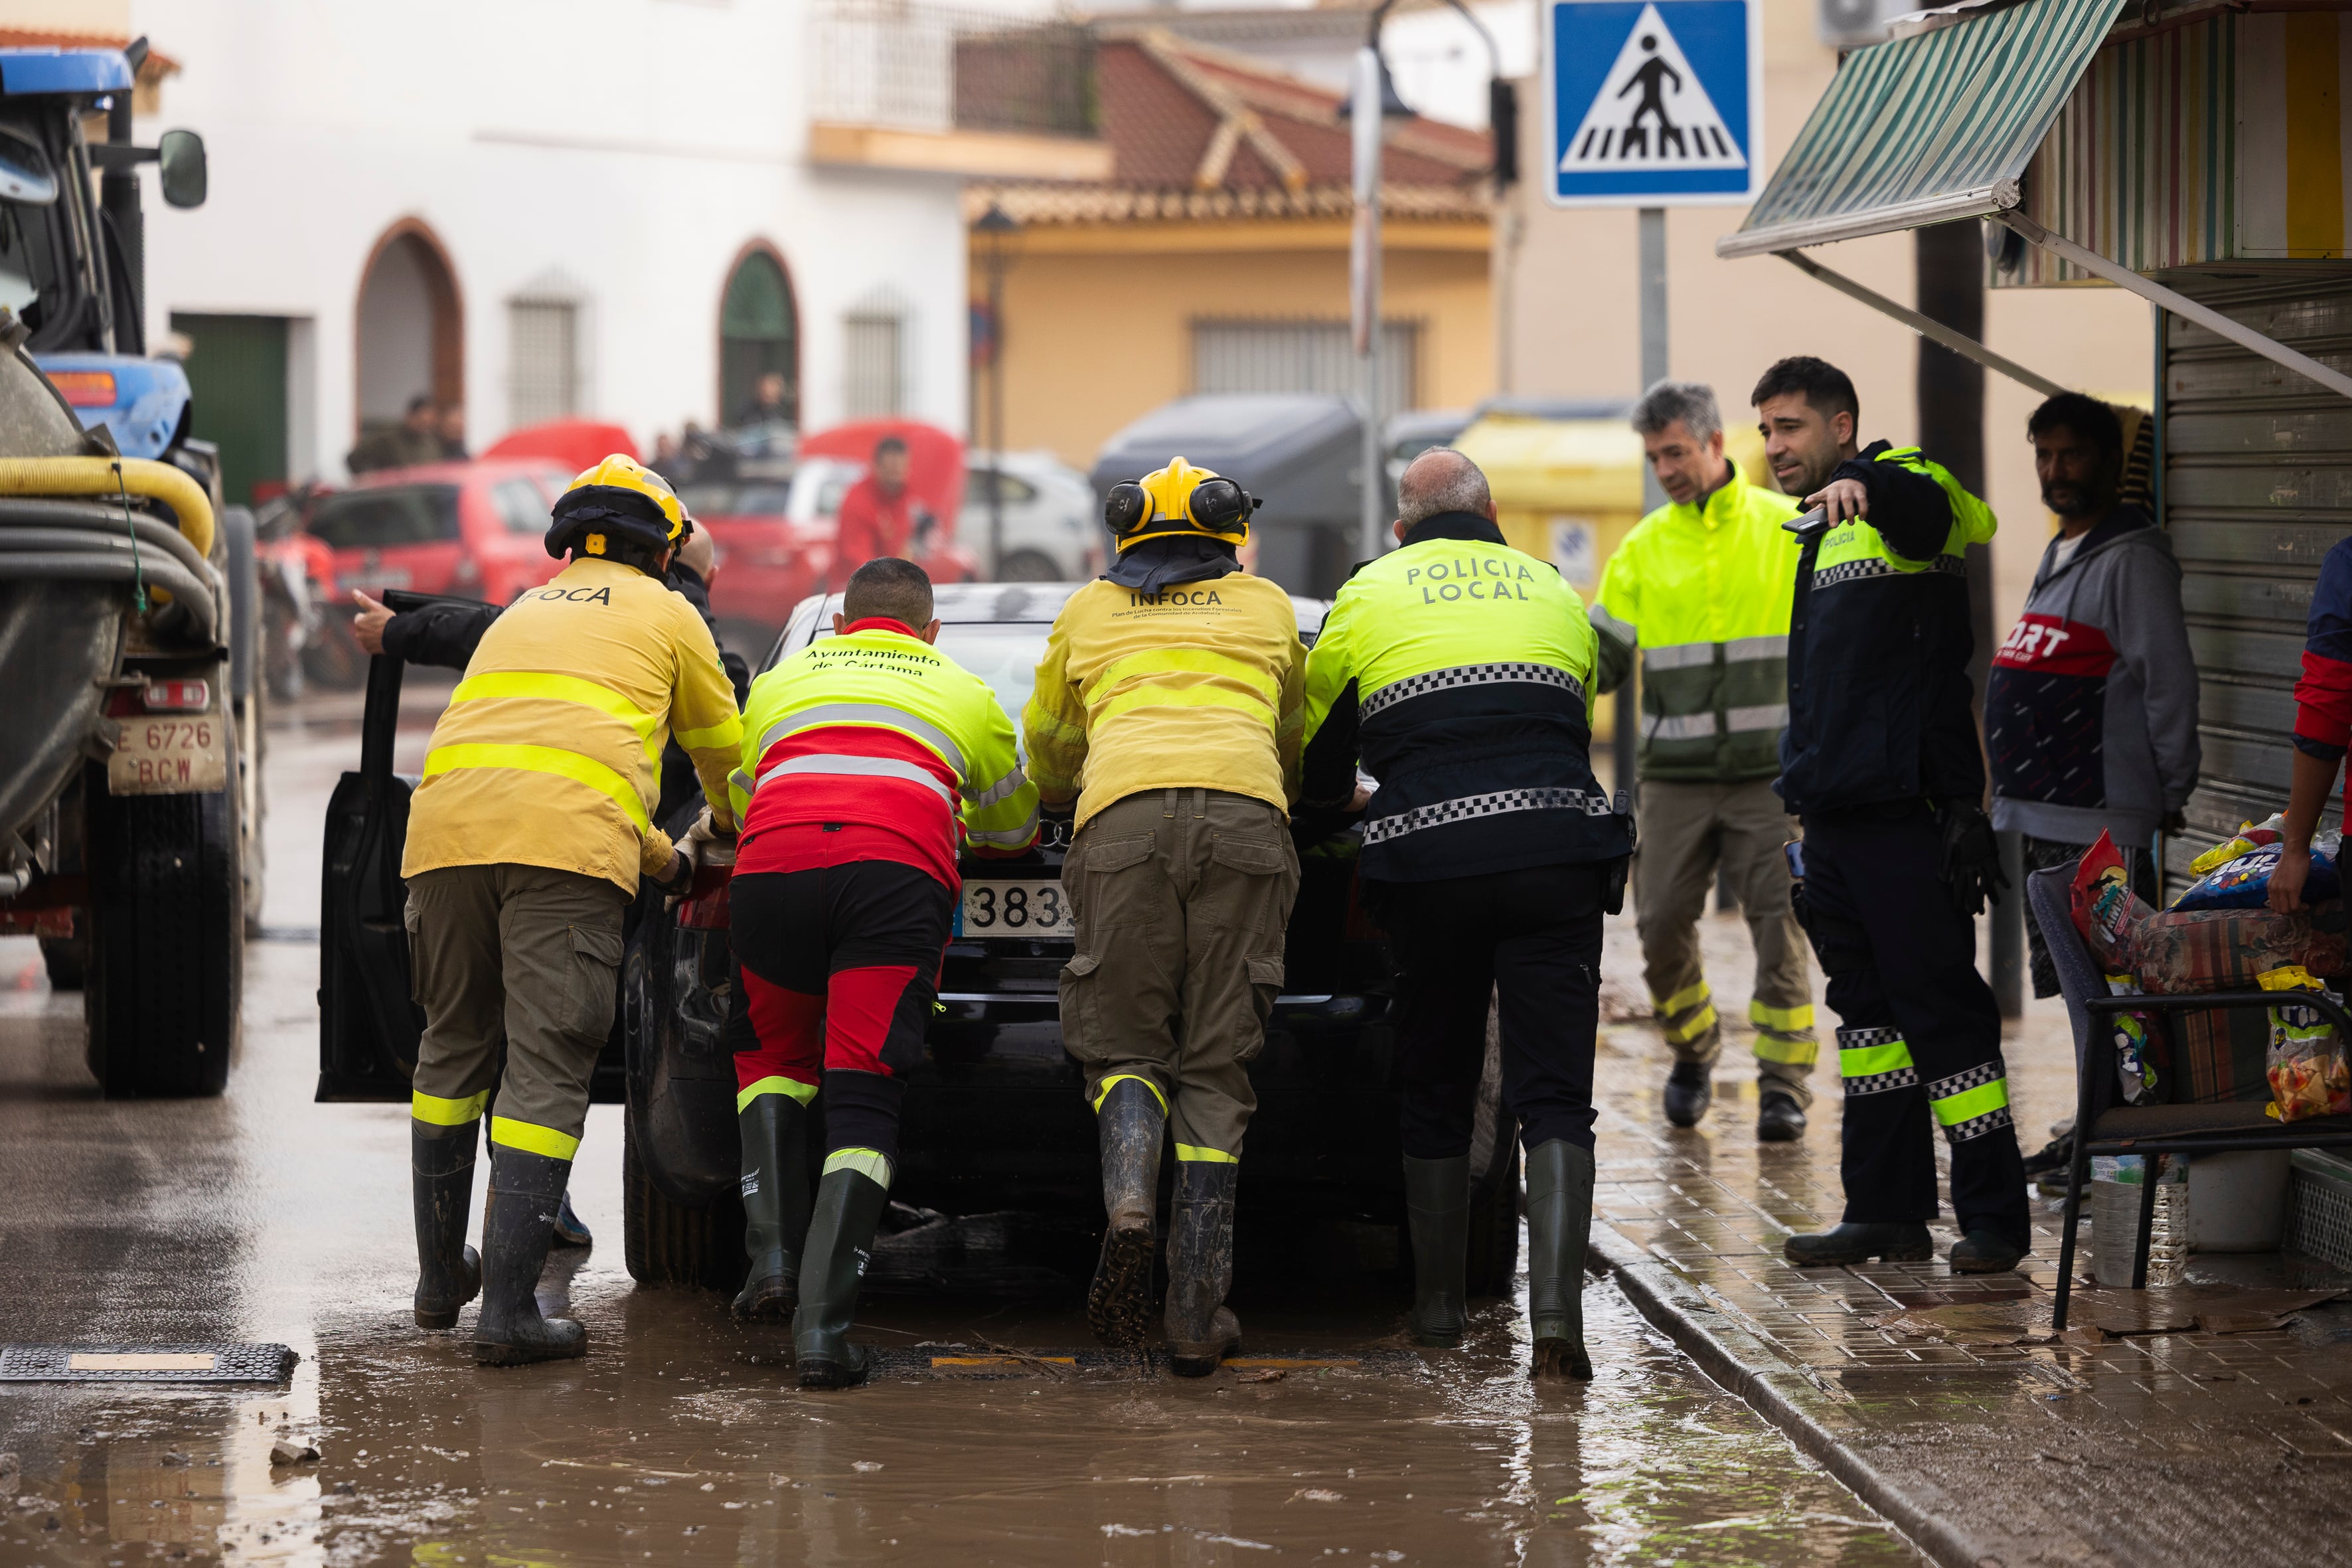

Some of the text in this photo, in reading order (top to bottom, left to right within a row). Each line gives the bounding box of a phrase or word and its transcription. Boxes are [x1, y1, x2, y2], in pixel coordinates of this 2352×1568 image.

[1407, 558, 1535, 586] POLICIA
[508, 587, 610, 611] FOCA
[1131, 590, 1222, 607] INFOCA
[1423, 581, 1529, 604] LOCAL
[805, 649, 940, 666] Ayuntamiento
[118, 721, 211, 752] E 6726
[139, 757, 191, 786] BCW
[971, 887, 1075, 928] 383
